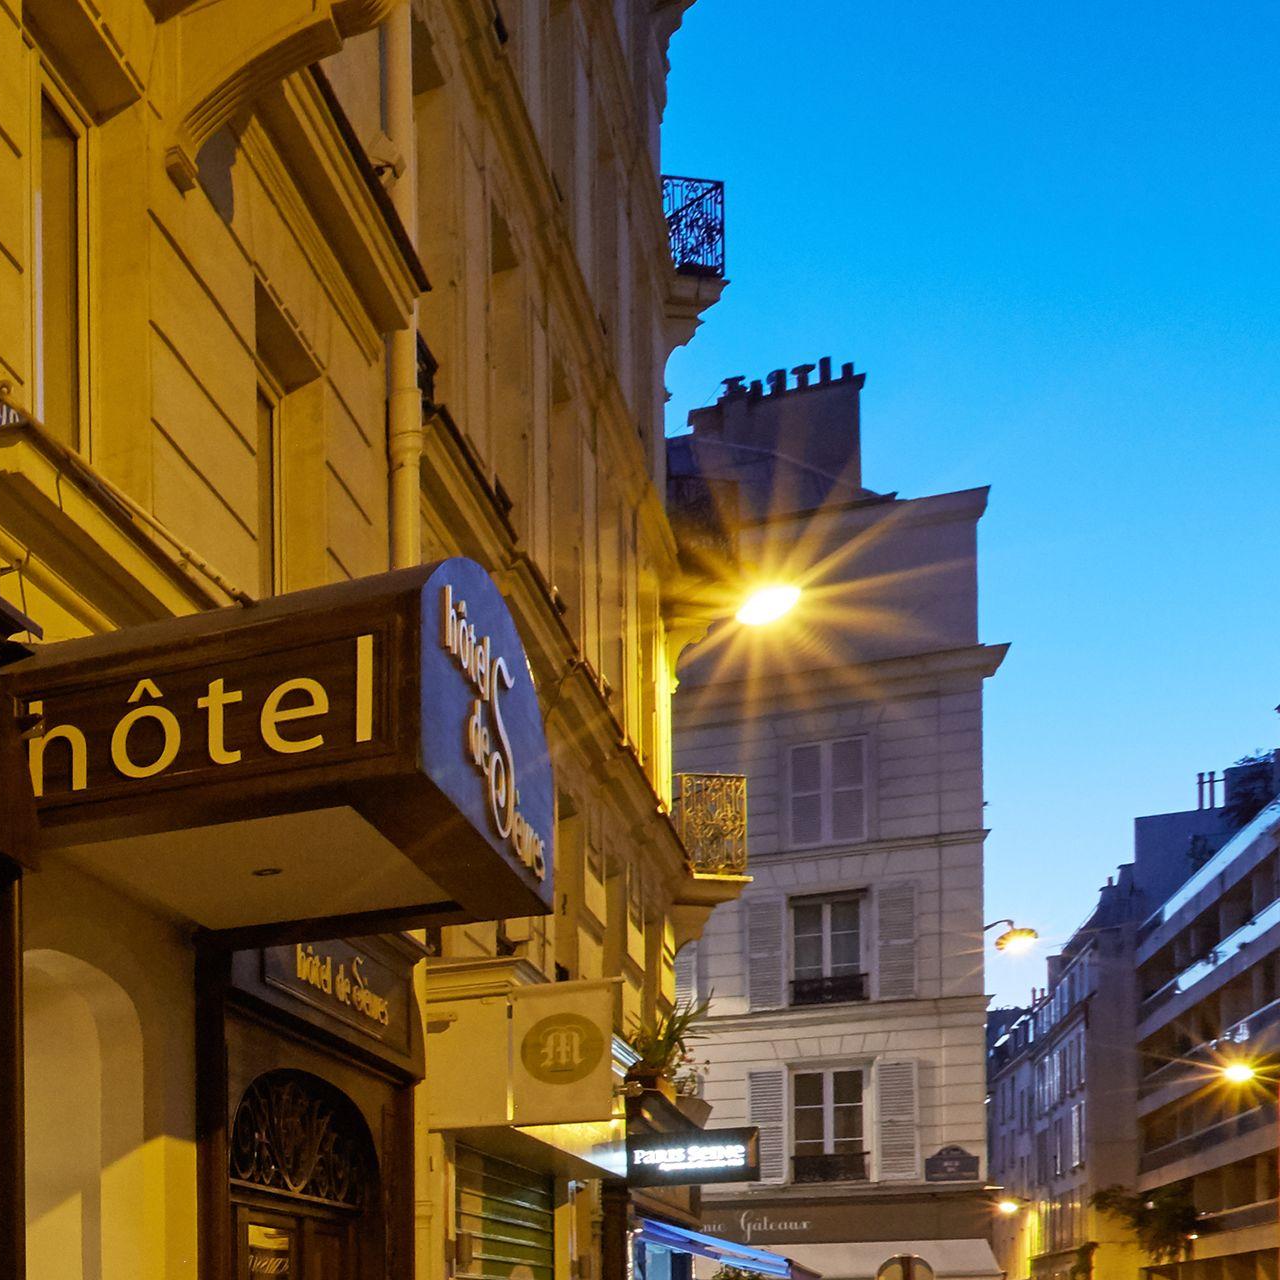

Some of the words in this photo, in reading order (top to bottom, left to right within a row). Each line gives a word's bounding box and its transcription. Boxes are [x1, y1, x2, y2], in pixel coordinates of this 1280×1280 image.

[443, 584, 491, 702] hôtel
[28, 633, 374, 798] hôtel
[467, 699, 491, 777] de
[335, 963, 351, 1005] de
[739, 1208, 812, 1242] Gâteaux
